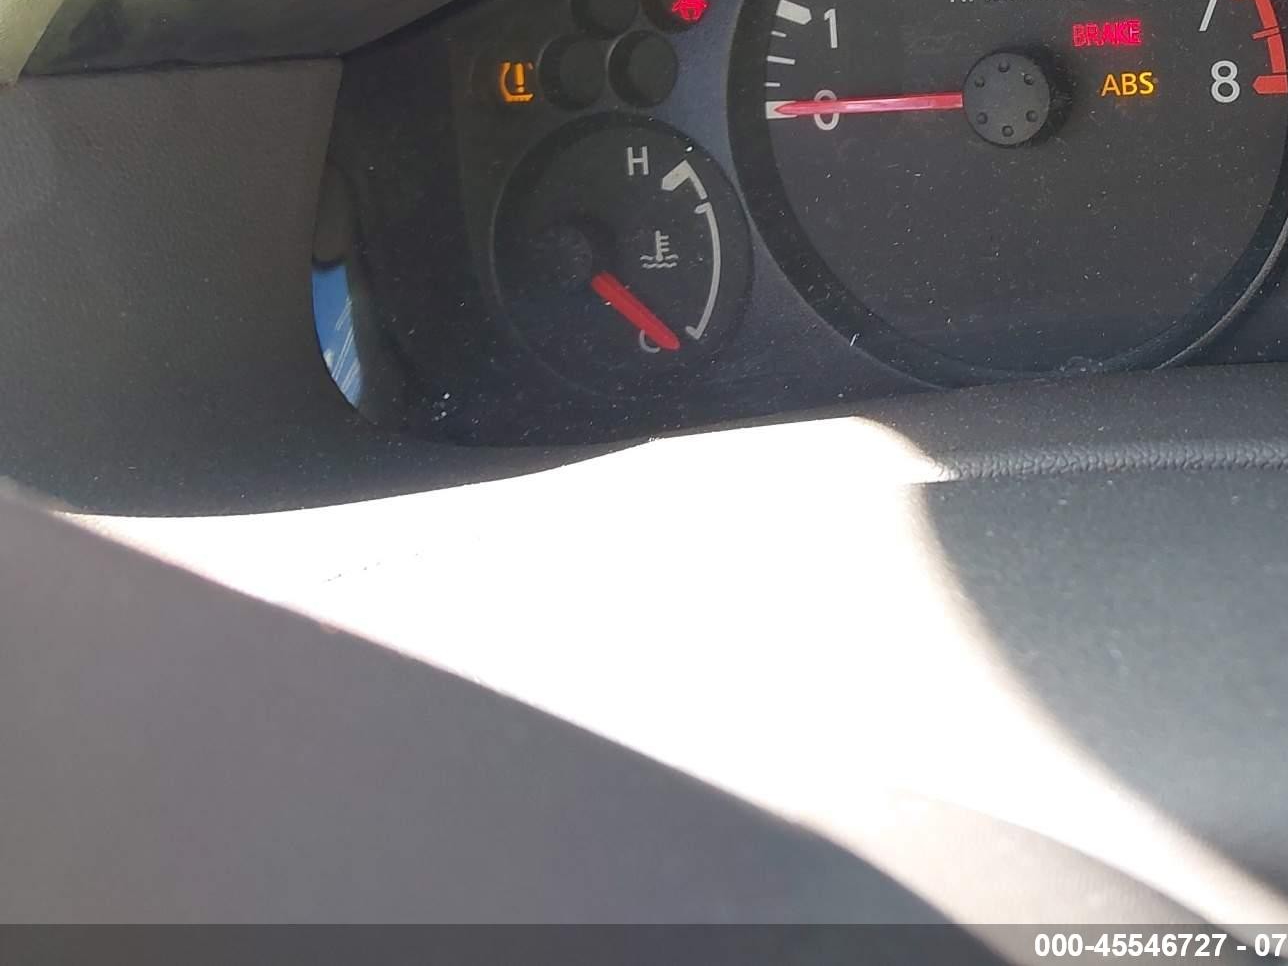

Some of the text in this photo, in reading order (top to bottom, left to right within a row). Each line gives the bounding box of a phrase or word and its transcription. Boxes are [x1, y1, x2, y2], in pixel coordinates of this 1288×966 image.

[823, 8, 838, 49] 1
[1073, 19, 1142, 47] BRAKE
[1101, 71, 1155, 96] ABS
[1211, 60, 1241, 103] 8
[813, 89, 840, 131] 0
[627, 146, 649, 176] H
